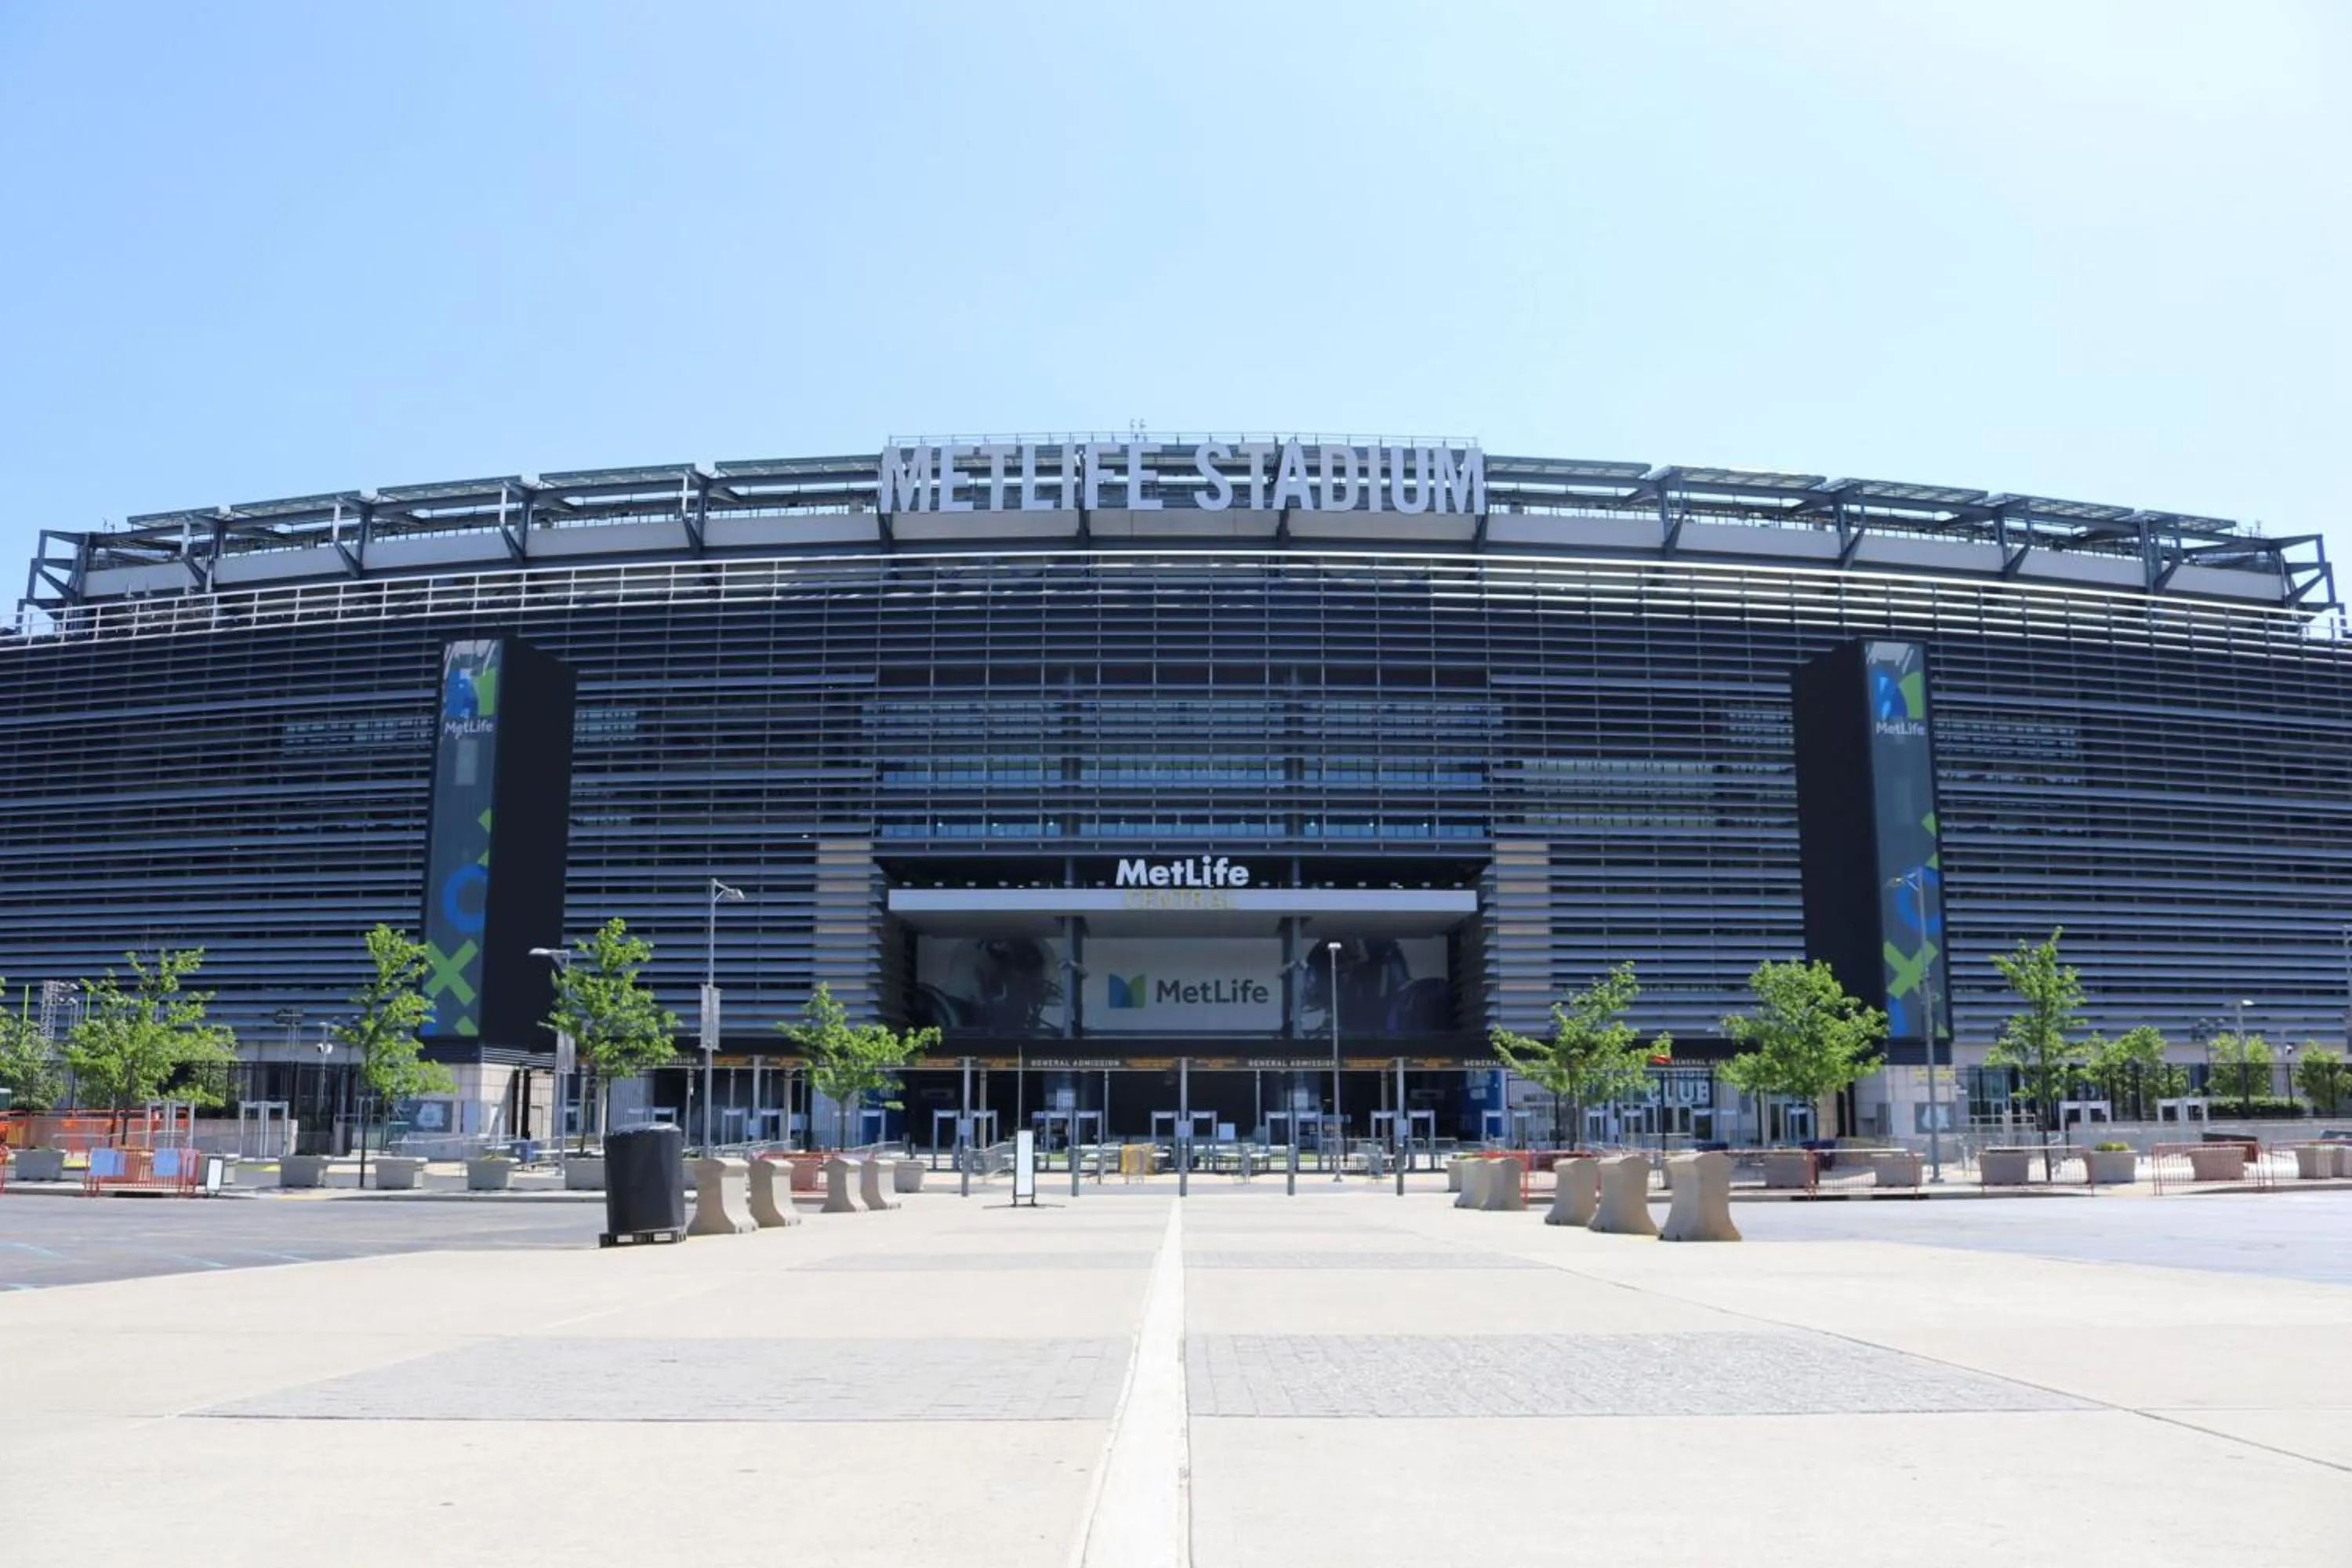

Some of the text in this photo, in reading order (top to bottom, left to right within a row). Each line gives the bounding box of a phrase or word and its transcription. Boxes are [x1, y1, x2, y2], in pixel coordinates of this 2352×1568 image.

[879, 441, 1486, 515] METLIFE STADIUM
[445, 720, 494, 732] MetLife
[1875, 721, 1926, 735] MetLife
[1116, 855, 1250, 886] MetLife
[1124, 888, 1236, 909] CENTRAL
[1156, 979, 1269, 1004] MetLife
